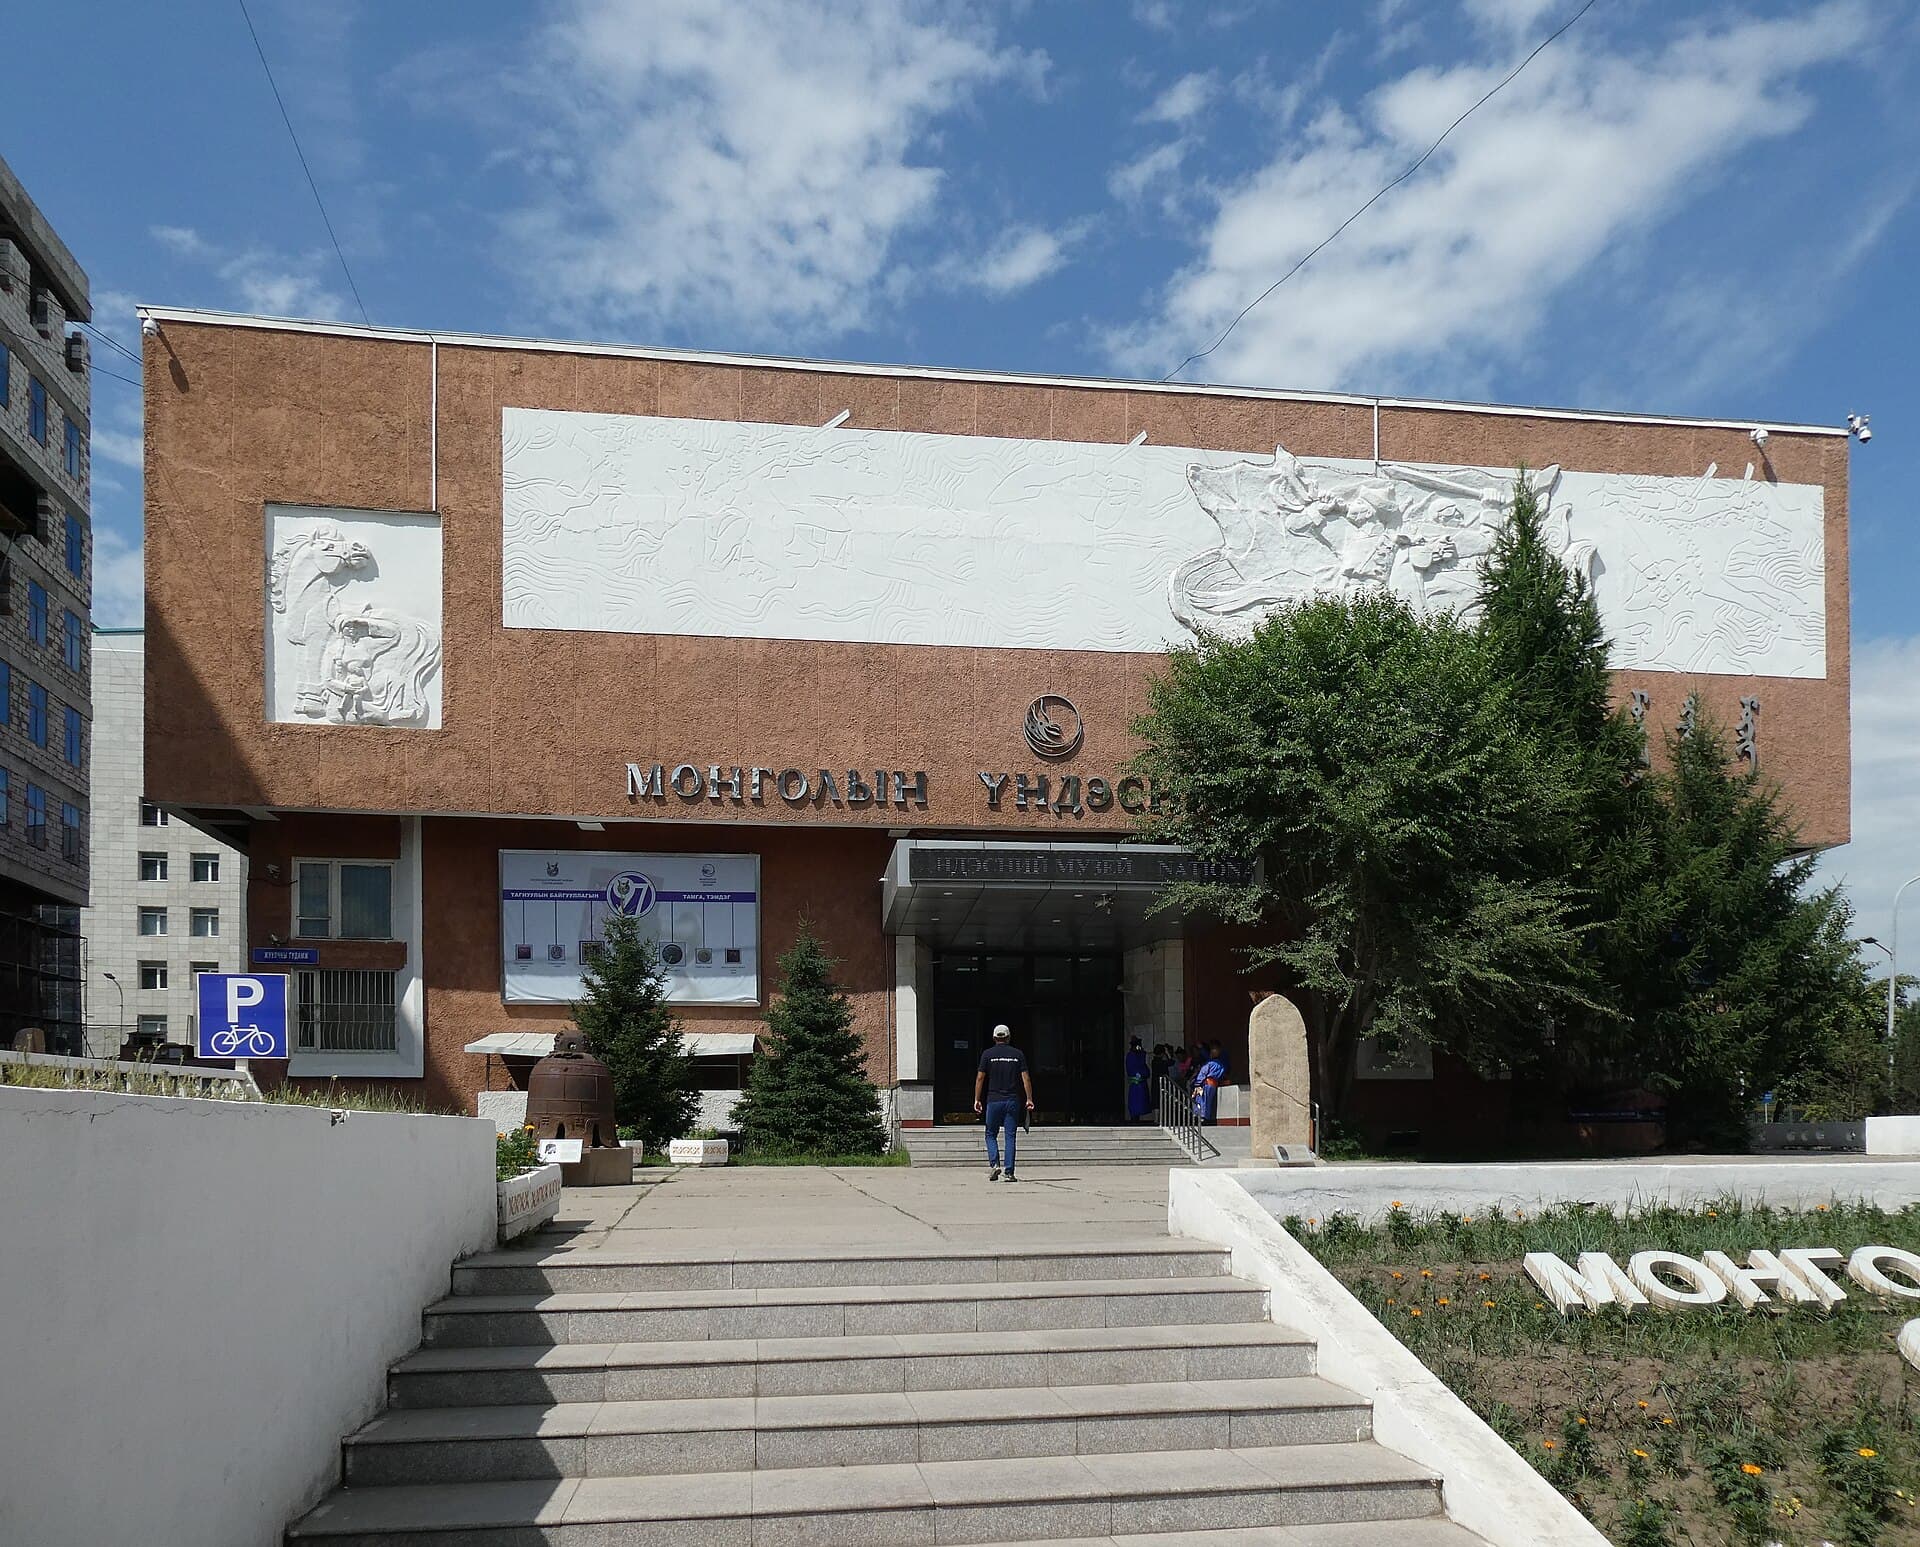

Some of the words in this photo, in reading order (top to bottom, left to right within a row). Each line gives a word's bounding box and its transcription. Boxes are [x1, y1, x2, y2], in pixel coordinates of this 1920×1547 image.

[625, 763, 928, 804] МОНГОЛЫН
[226, 977, 265, 1023] P
[1522, 1245, 1920, 1316] МОНГО
